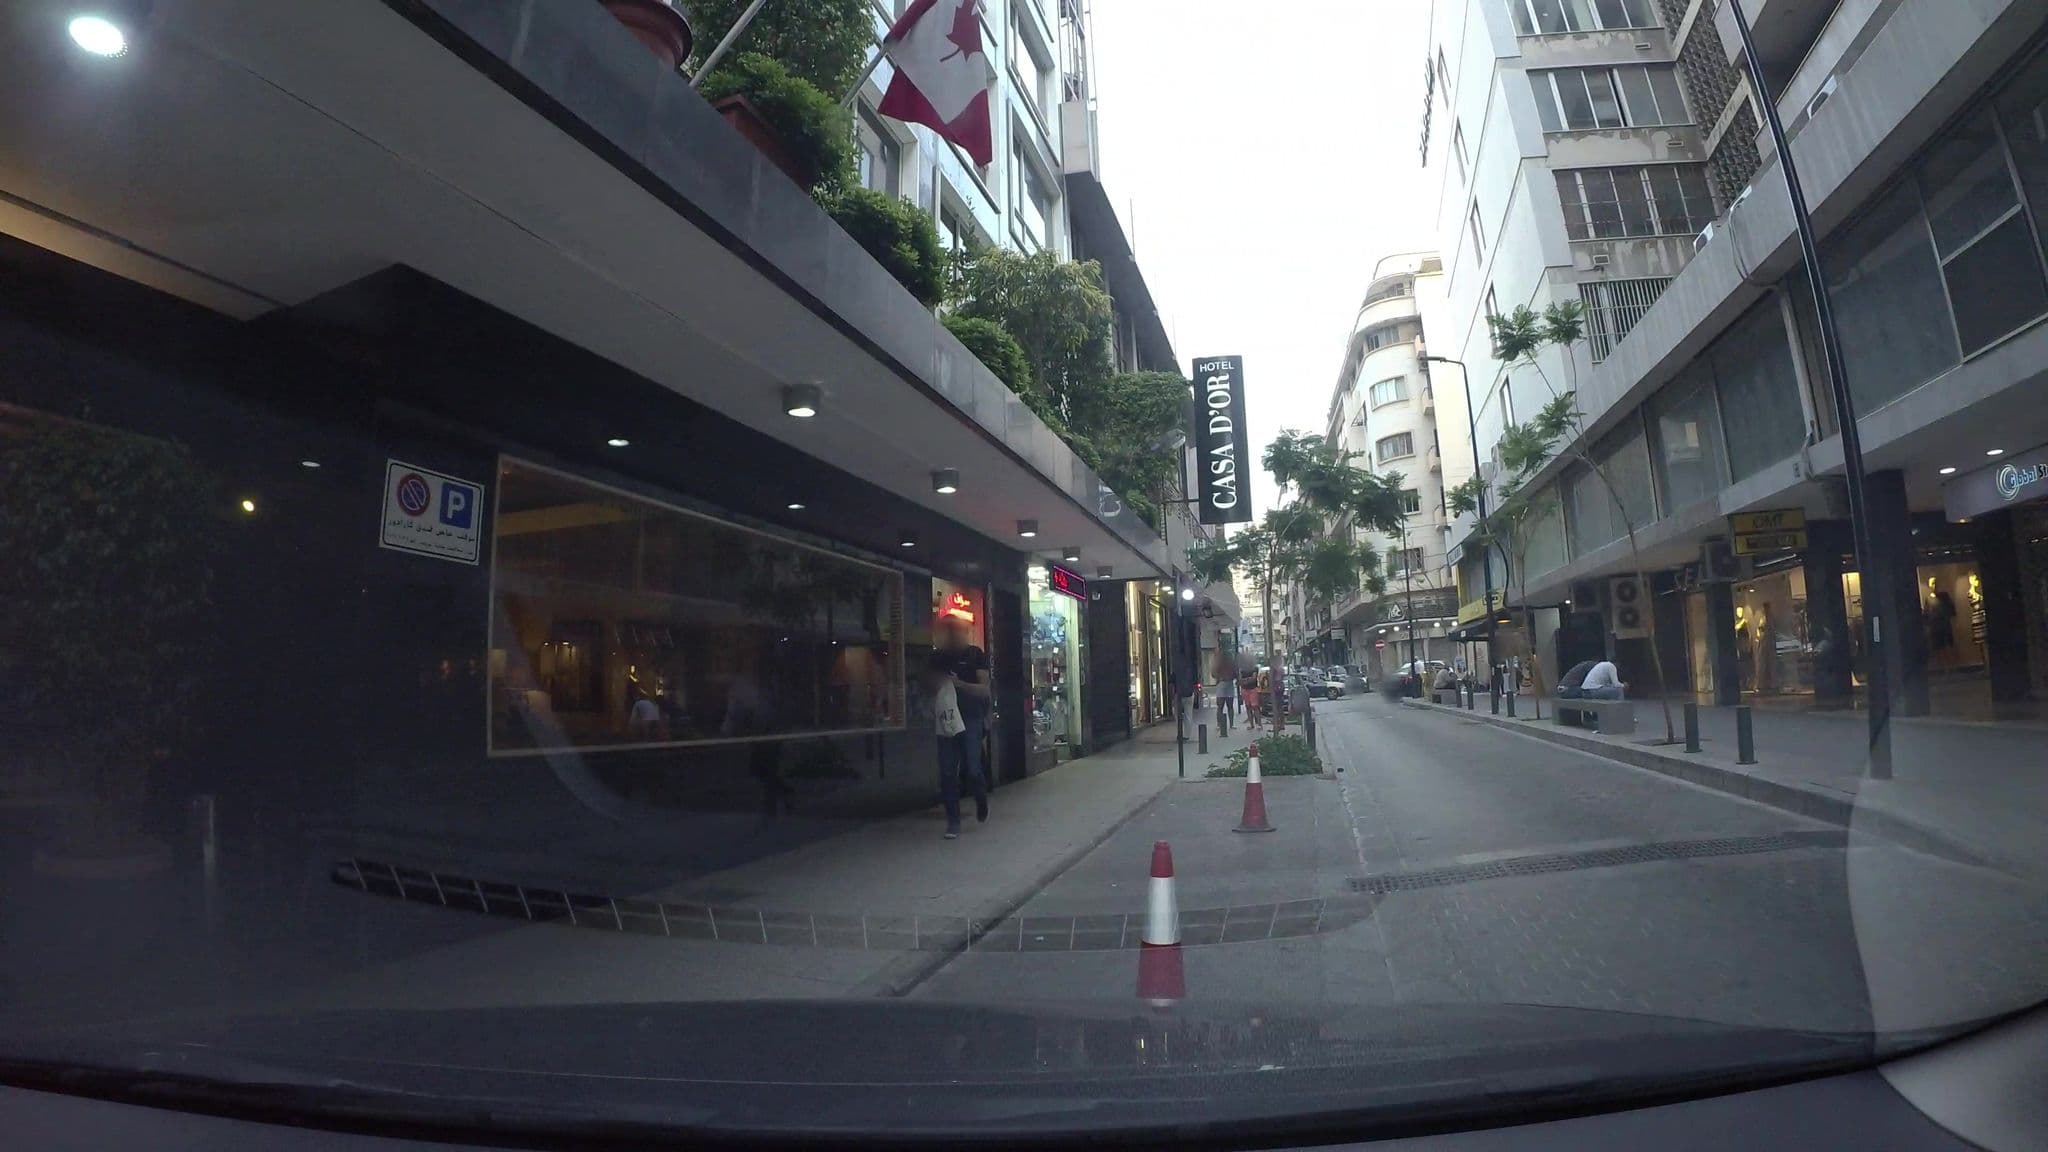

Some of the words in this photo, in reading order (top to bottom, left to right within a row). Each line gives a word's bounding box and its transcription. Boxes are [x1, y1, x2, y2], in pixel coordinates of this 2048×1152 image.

[1199, 361, 1235, 373] HOTEL
[1207, 373, 1232, 435] D'OR
[1210, 442, 1237, 509] CASA
[447, 490, 466, 519] P
